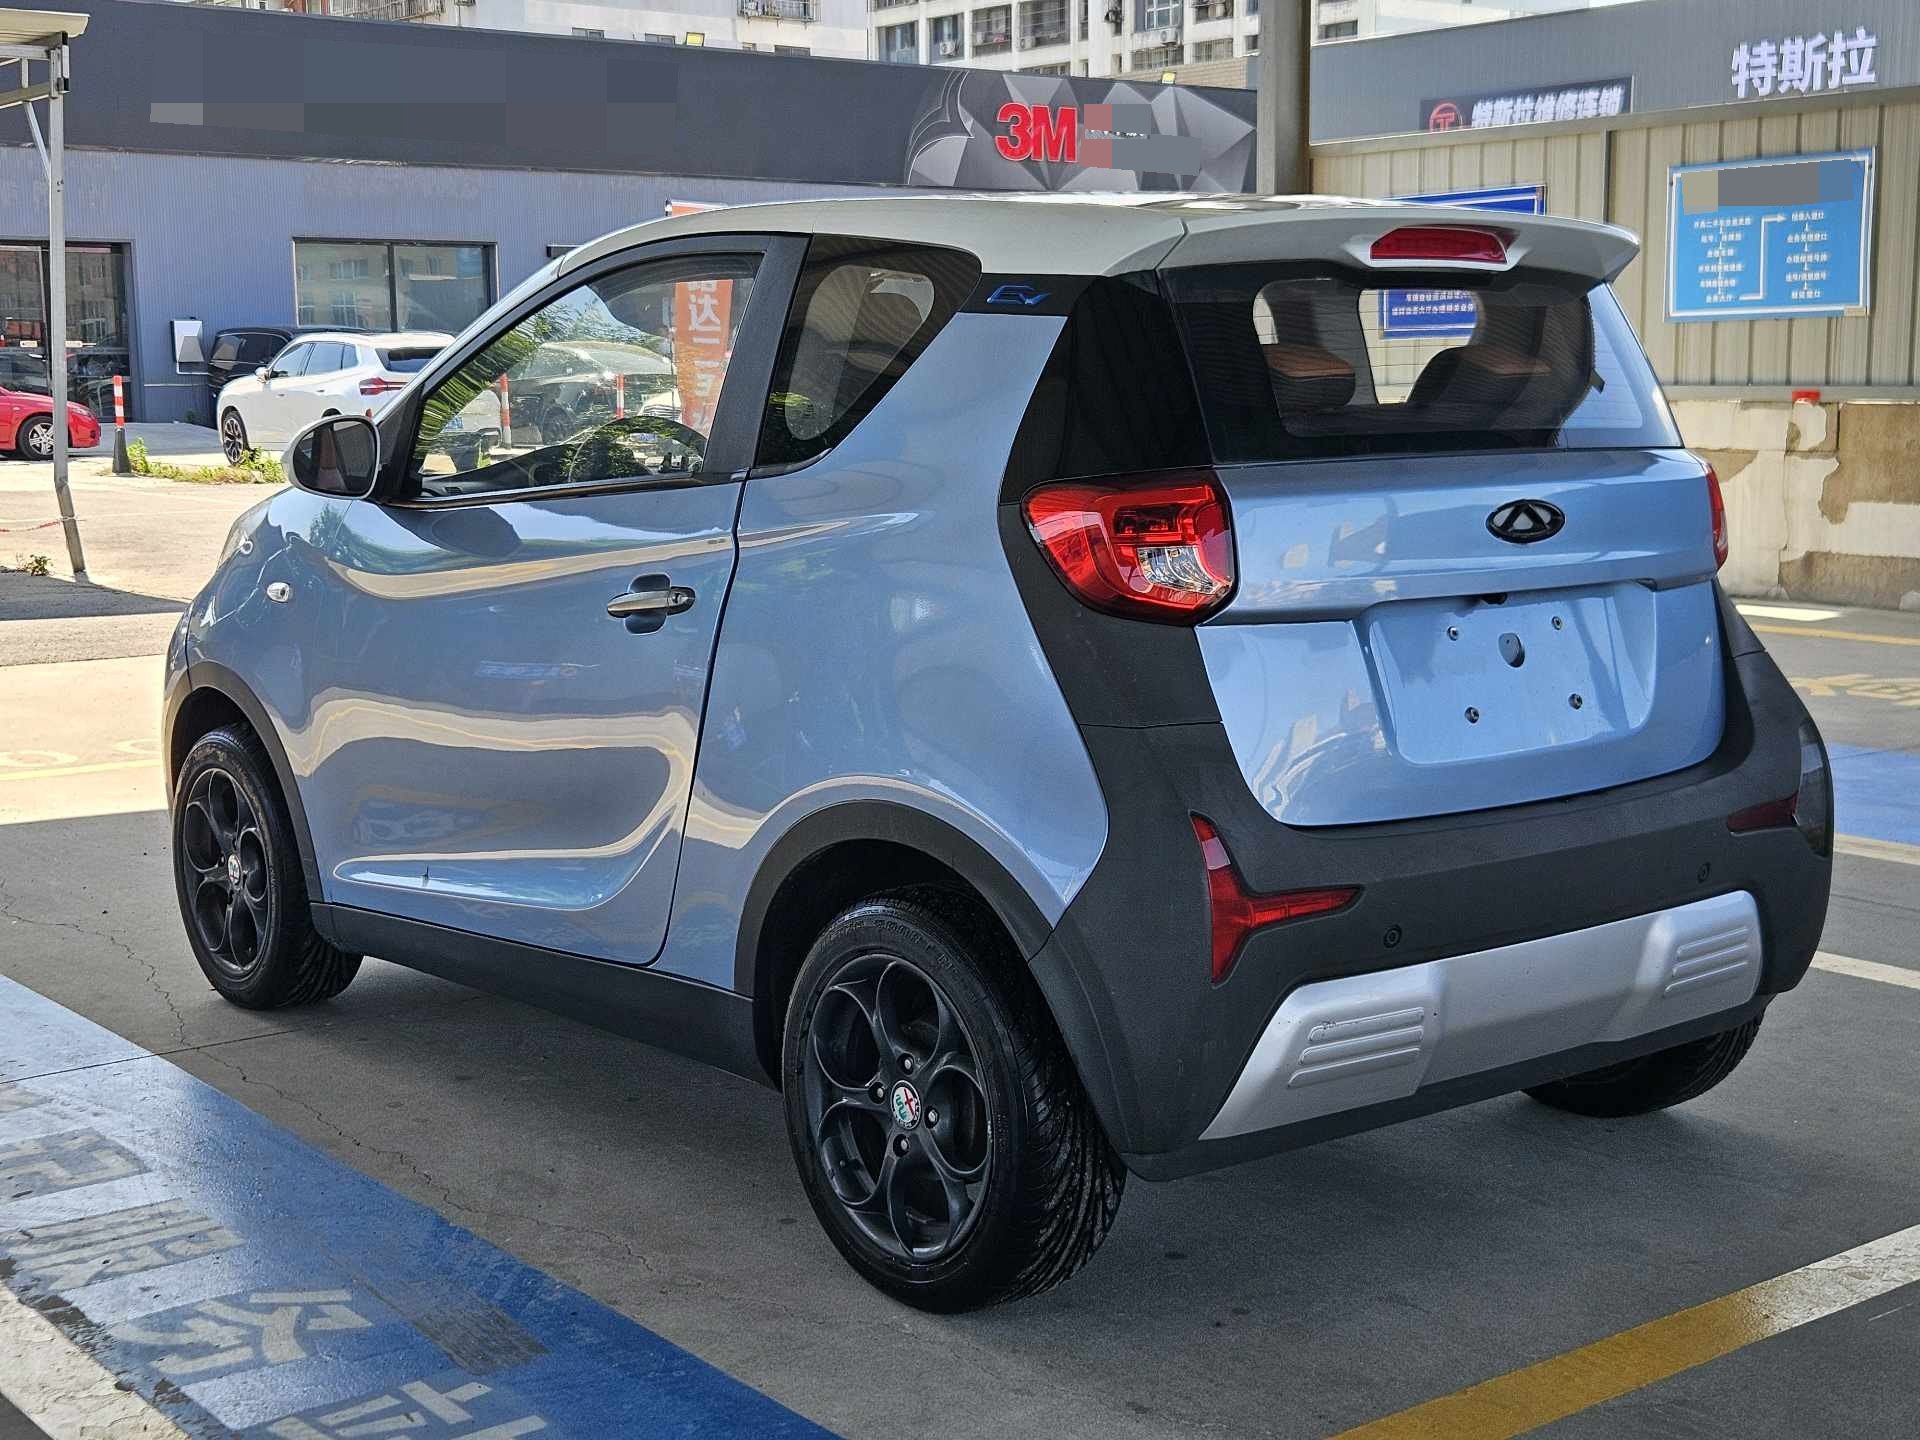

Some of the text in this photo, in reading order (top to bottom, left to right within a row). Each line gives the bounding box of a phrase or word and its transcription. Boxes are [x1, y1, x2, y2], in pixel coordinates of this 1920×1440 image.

[1731, 25, 1877, 99] 特斯拉
[995, 102, 1079, 163] 3M
